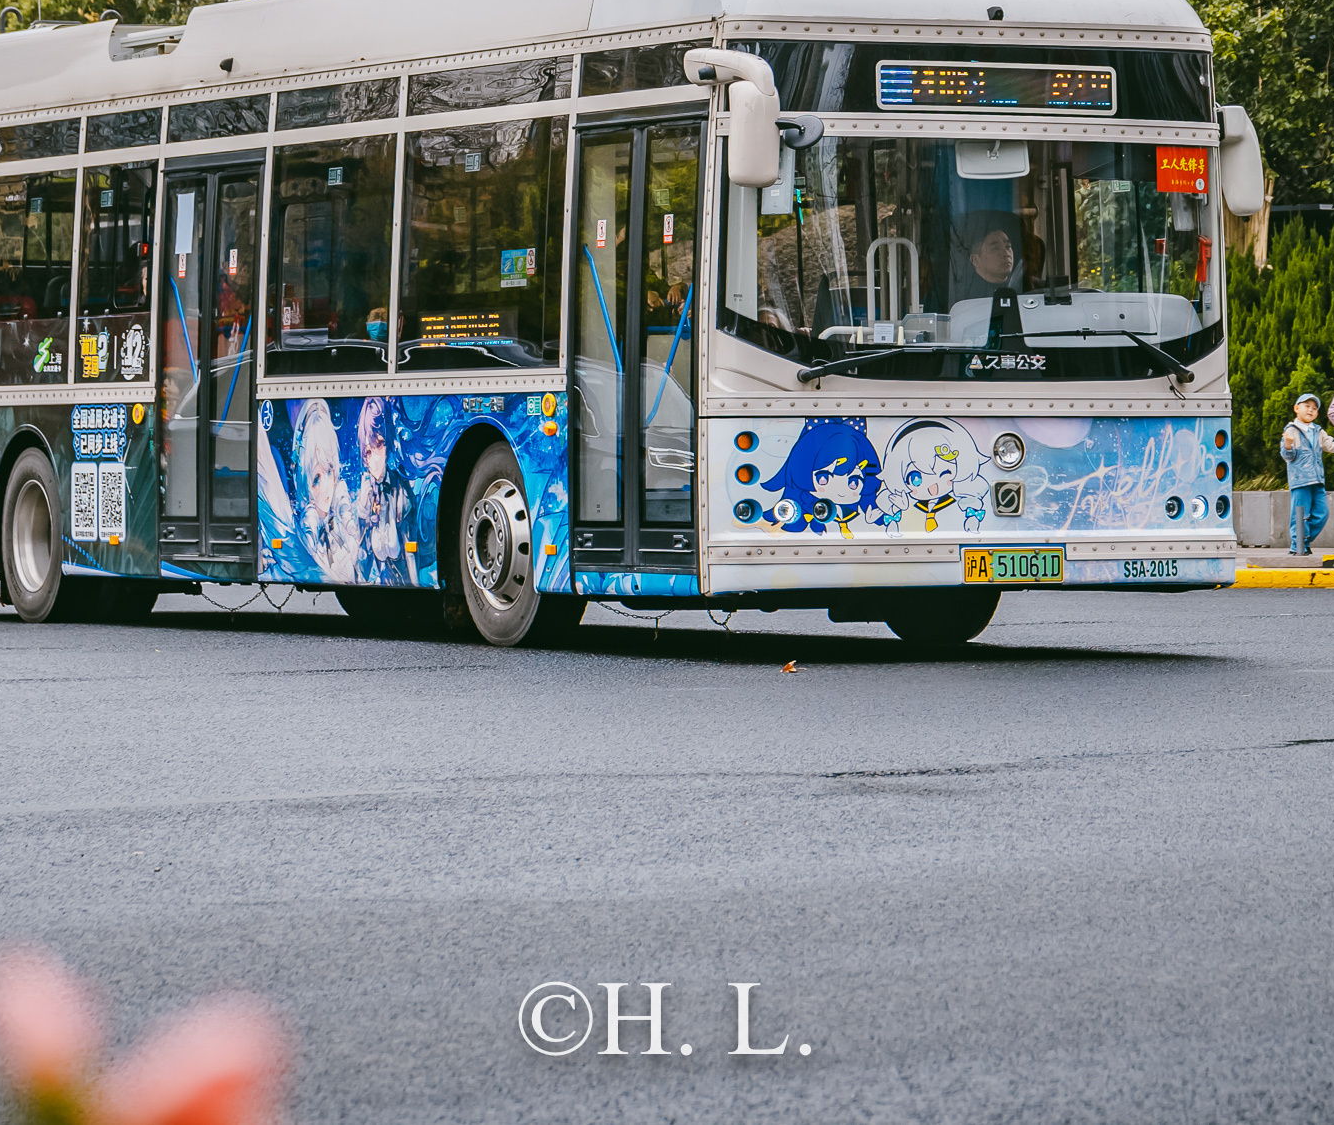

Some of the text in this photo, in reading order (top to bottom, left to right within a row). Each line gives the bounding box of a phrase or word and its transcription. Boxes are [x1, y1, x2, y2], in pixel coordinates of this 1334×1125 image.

[1160, 157, 1205, 174] 工人先锋号
[49, 352, 62, 364] 上海
[984, 354, 1046, 370] 久事公交
[72, 407, 126, 429] 全国通用交通卡
[80, 433, 119, 455] 已同步上线
[967, 555, 1060, 578] 沪A 51061D
[1123, 560, 1178, 578] S5A-2015
